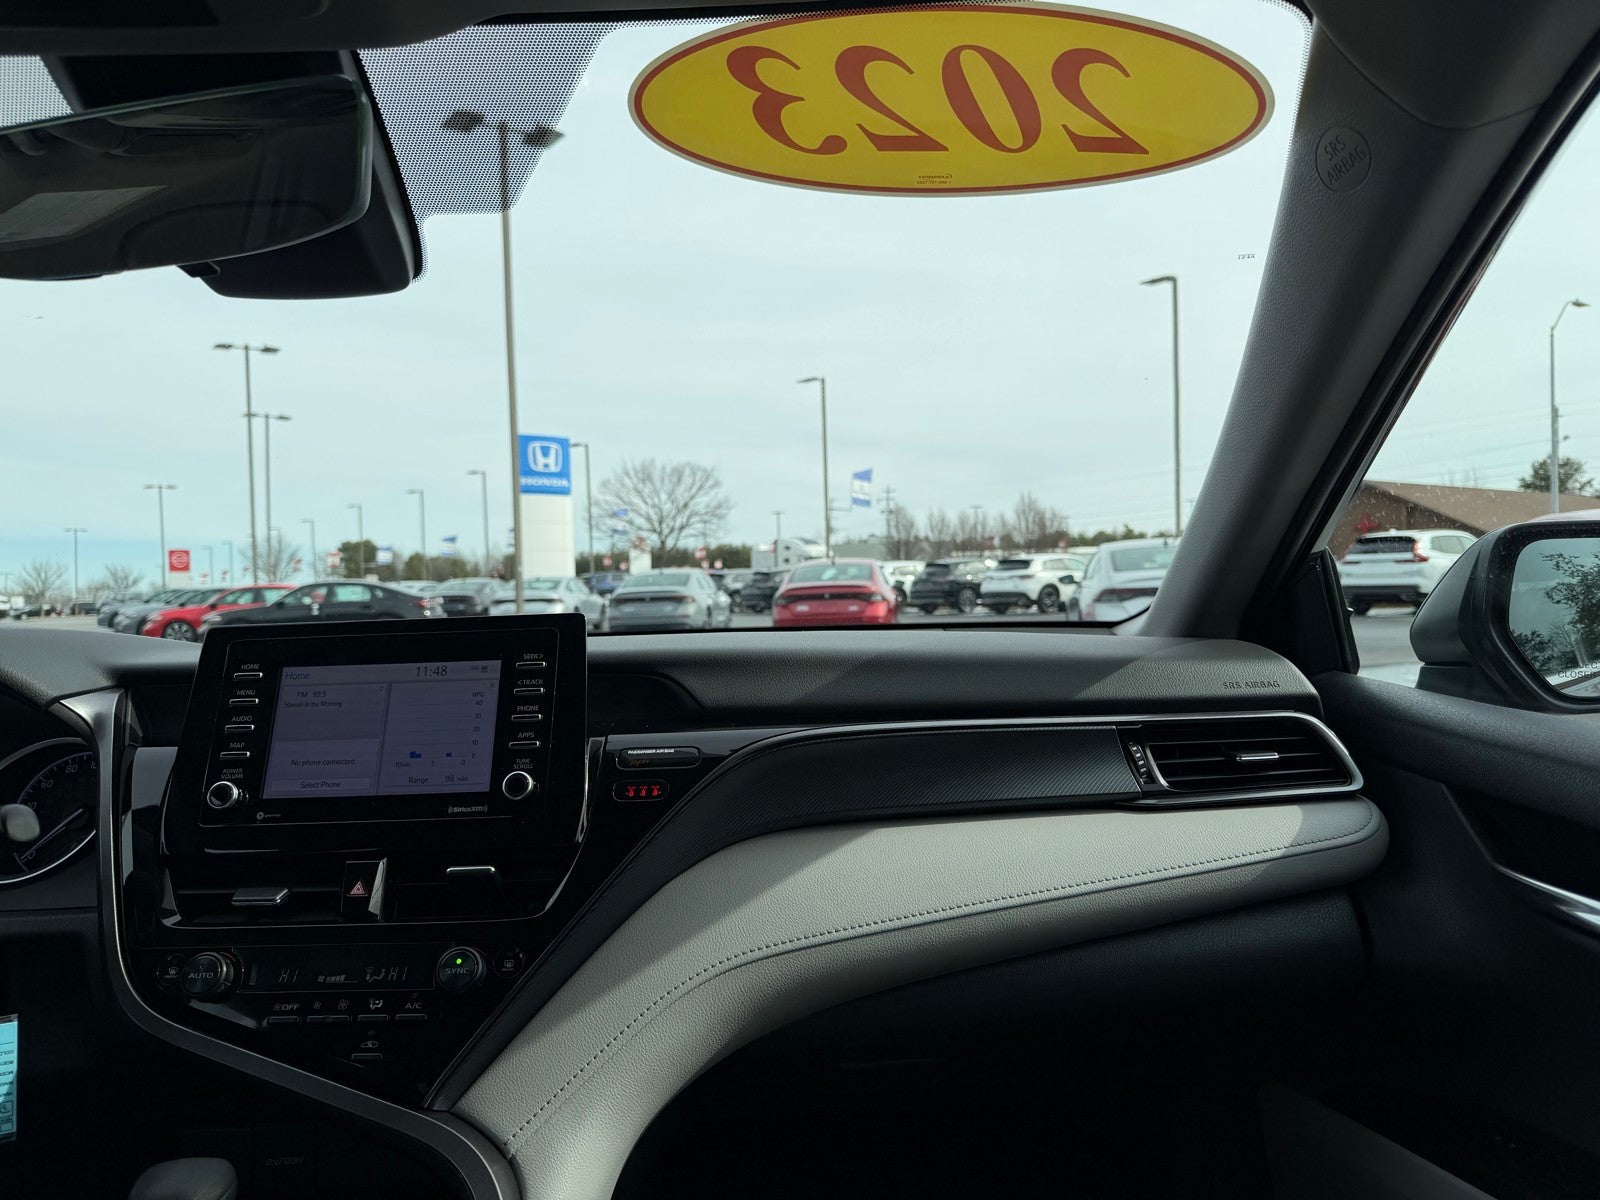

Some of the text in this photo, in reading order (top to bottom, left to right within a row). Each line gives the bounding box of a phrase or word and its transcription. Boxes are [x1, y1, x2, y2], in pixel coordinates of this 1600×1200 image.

[1324, 134, 1346, 161] SRS
[1327, 146, 1368, 185] AIRBAG
[1565, 661, 1600, 669] OBJEC
[285, 672, 311, 680] Home
[415, 666, 448, 677] 11:48
[1223, 680, 1280, 689] SRS AIRBAG
[321, 701, 343, 709] Morning
[302, 760, 321, 768] phone
[322, 758, 355, 766] connected
[65, 764, 78, 774] 80
[41, 779, 54, 788] 60
[300, 780, 341, 789] Select Phone
[408, 776, 429, 785] Range
[444, 775, 455, 783] 96
[282, 1003, 300, 1011] OFF
[405, 1001, 422, 1009] A/C
